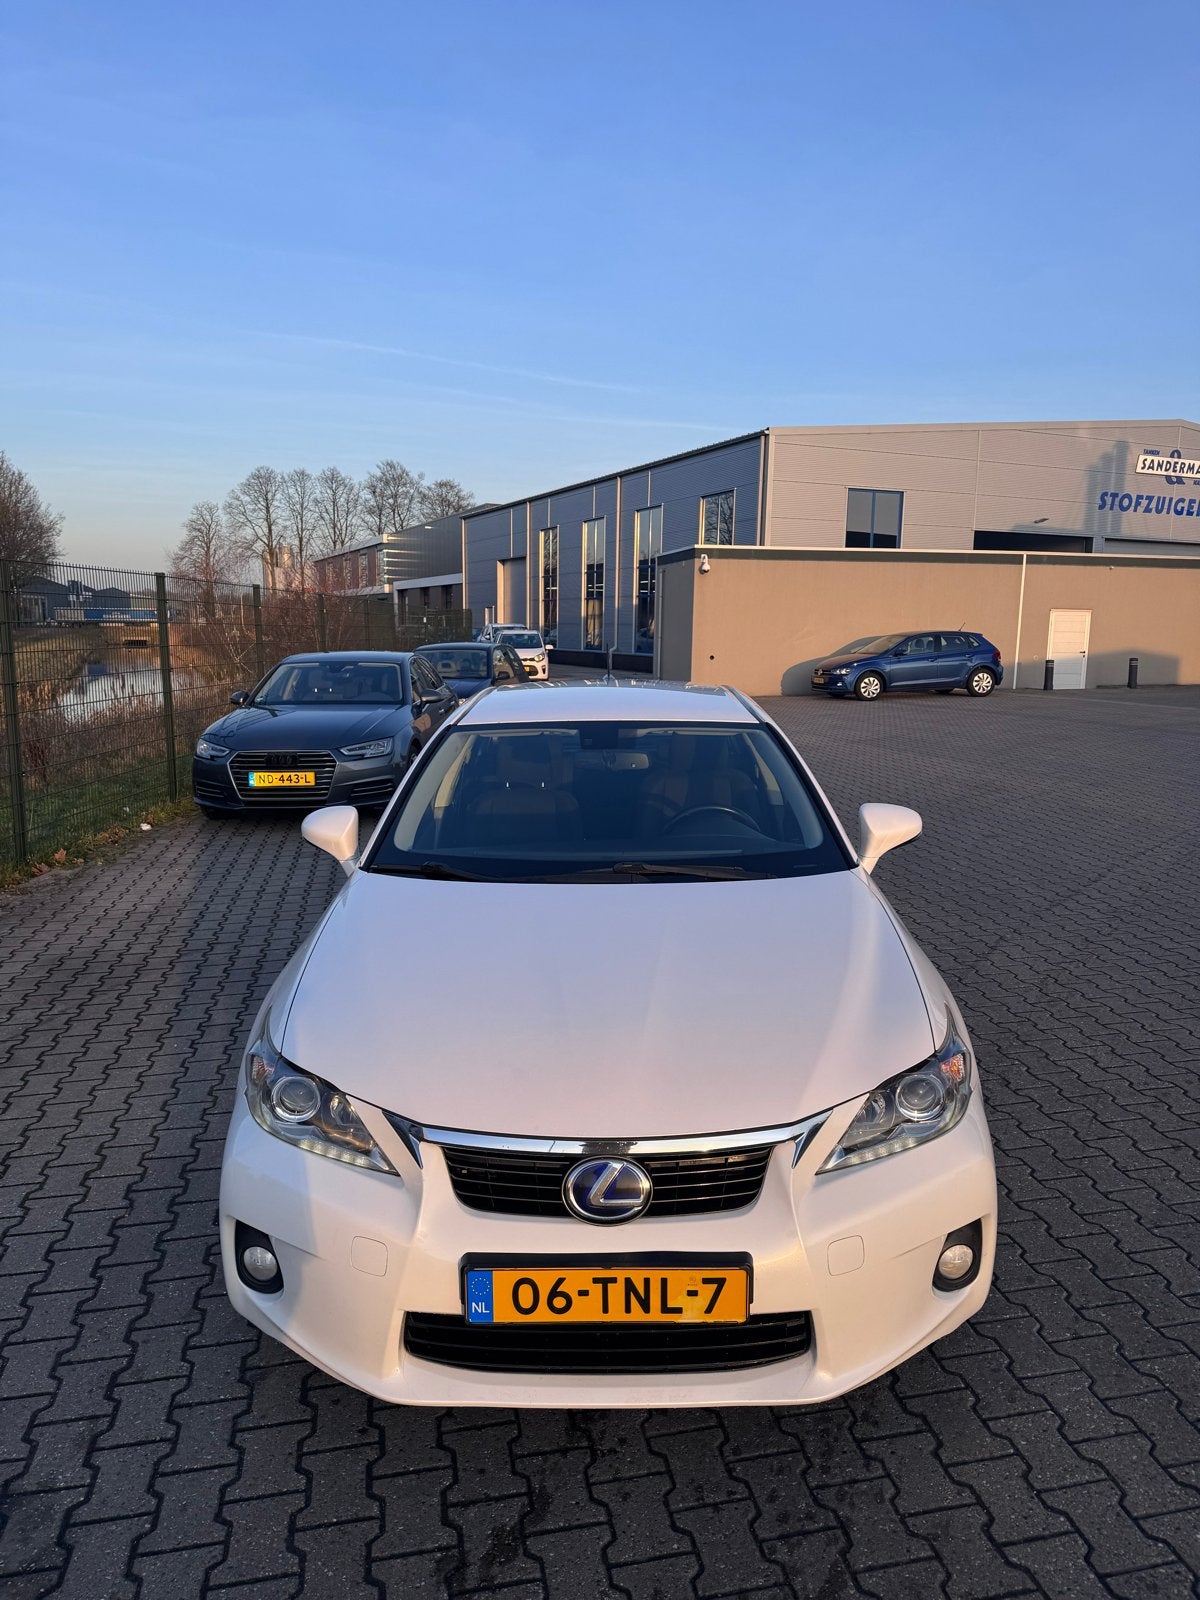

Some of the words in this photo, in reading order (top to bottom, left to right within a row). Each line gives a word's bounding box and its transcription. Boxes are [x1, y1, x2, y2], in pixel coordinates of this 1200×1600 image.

[258, 773, 311, 784] ND-443-L
[511, 1276, 727, 1316] 06-TNL-7
[471, 1301, 490, 1314] NL
